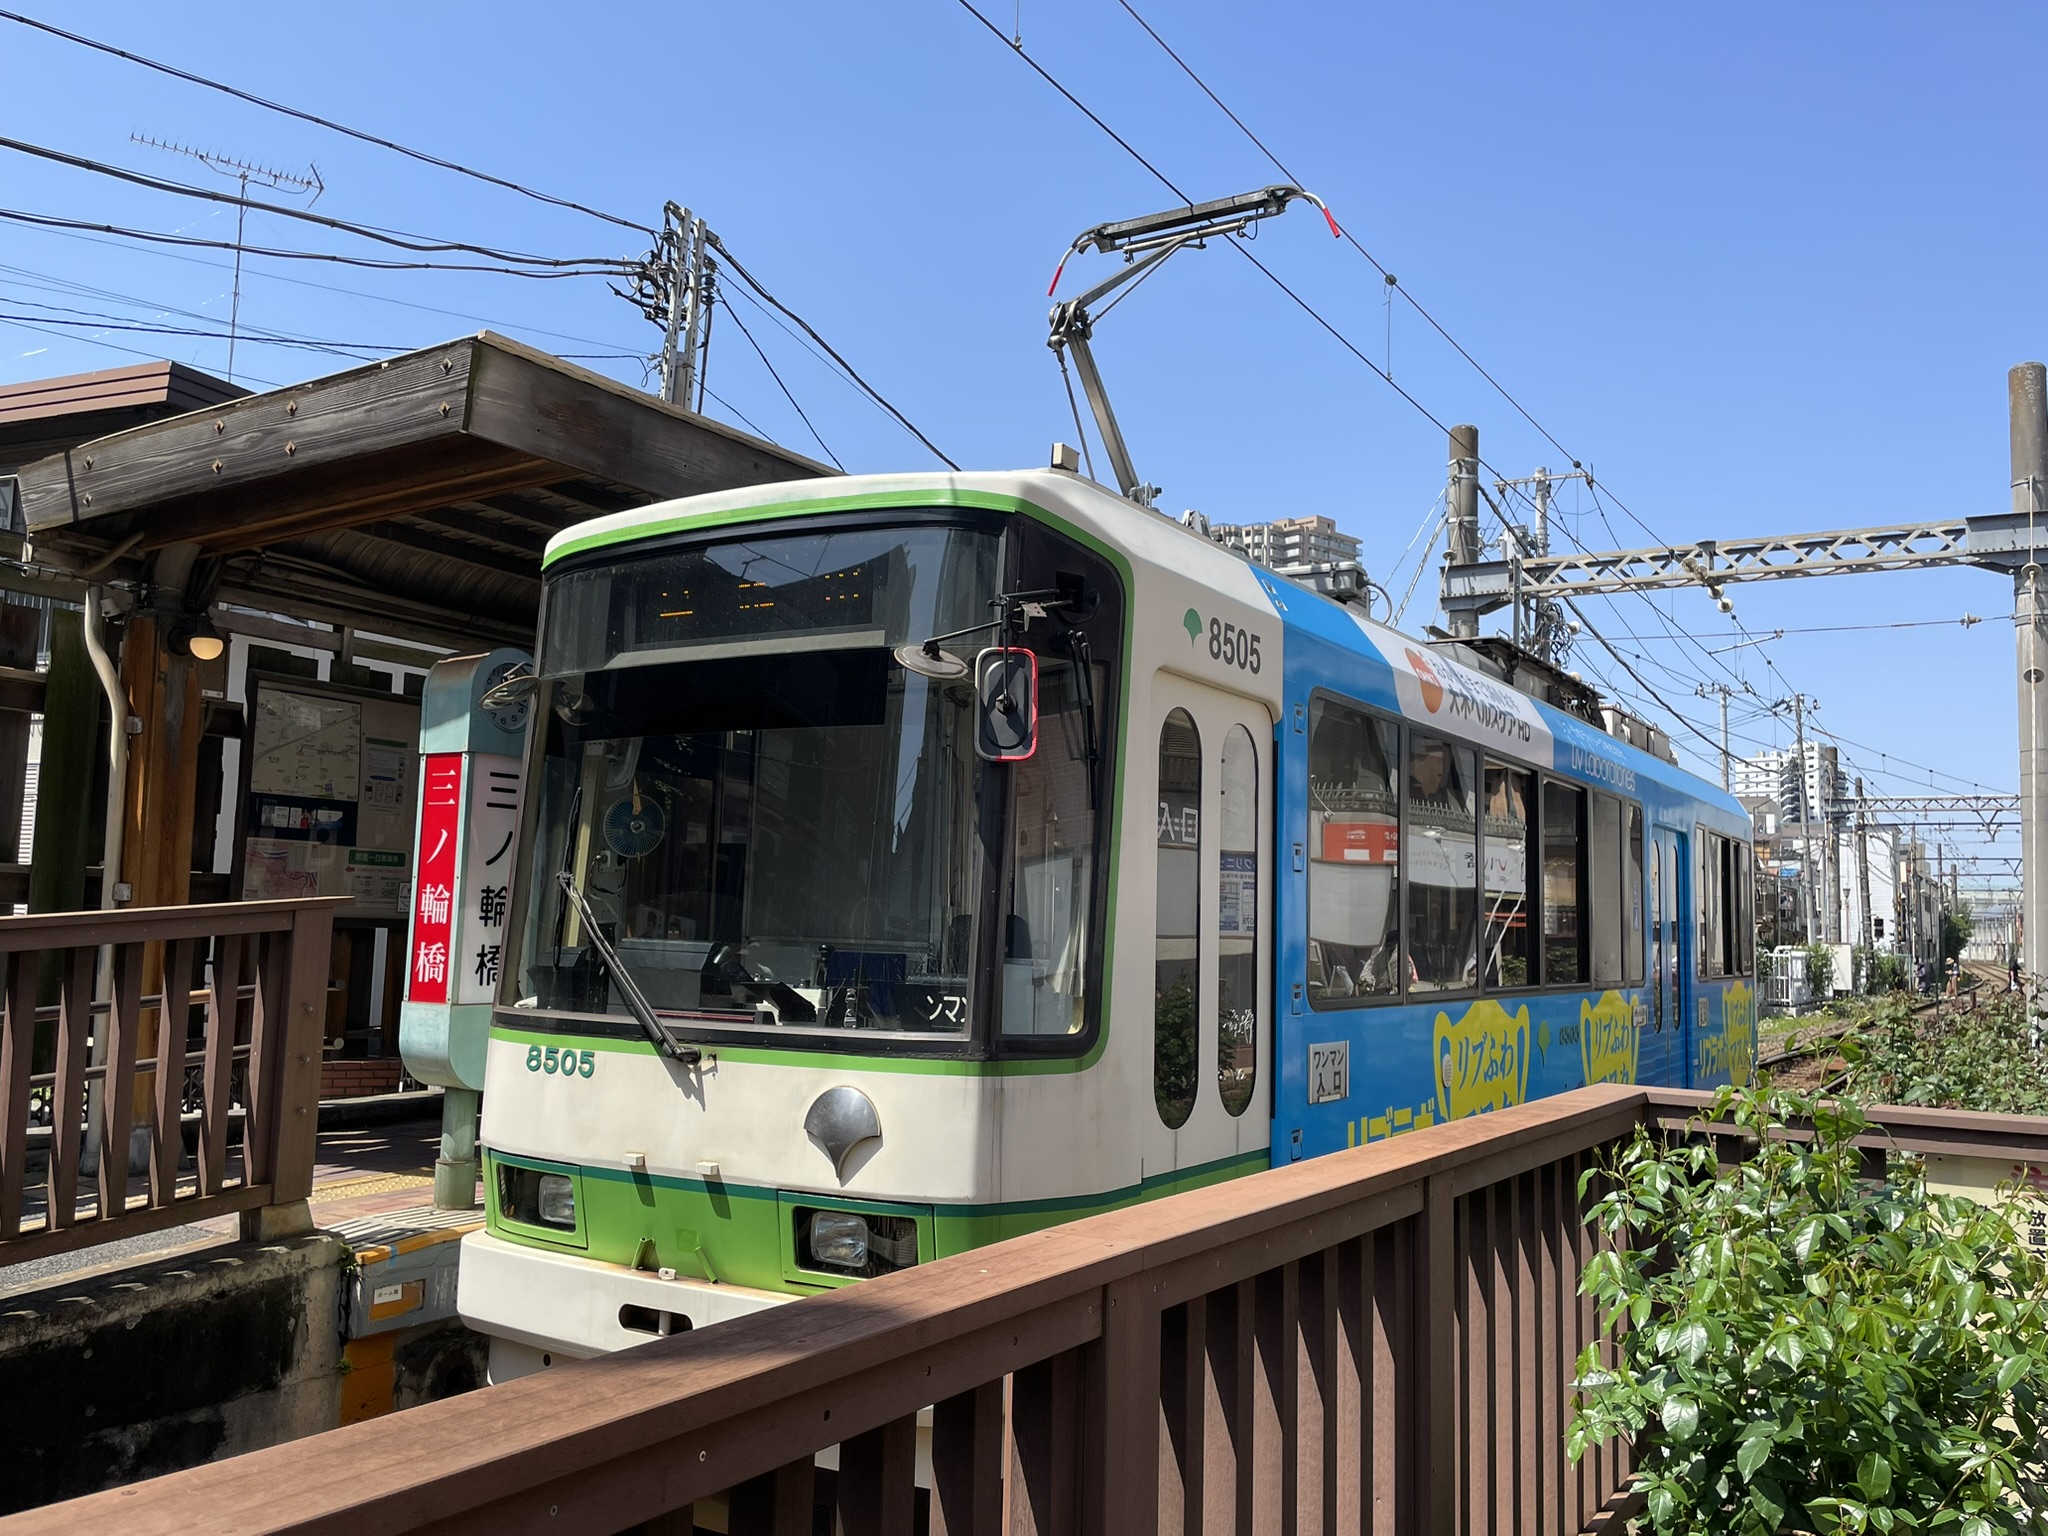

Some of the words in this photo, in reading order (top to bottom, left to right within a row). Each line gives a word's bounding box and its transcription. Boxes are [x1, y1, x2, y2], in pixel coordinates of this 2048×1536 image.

[1208, 617, 1261, 675] 8505
[511, 714, 518, 722] 5
[415, 769, 457, 984] 三ノ輪橋
[1595, 1014, 1629, 1059] リブふわ
[526, 1044, 596, 1079] 8505
[1313, 1049, 1345, 1070] ワンマン
[1458, 1030, 1514, 1090] リブふわ
[1316, 1072, 1342, 1095] 入口
